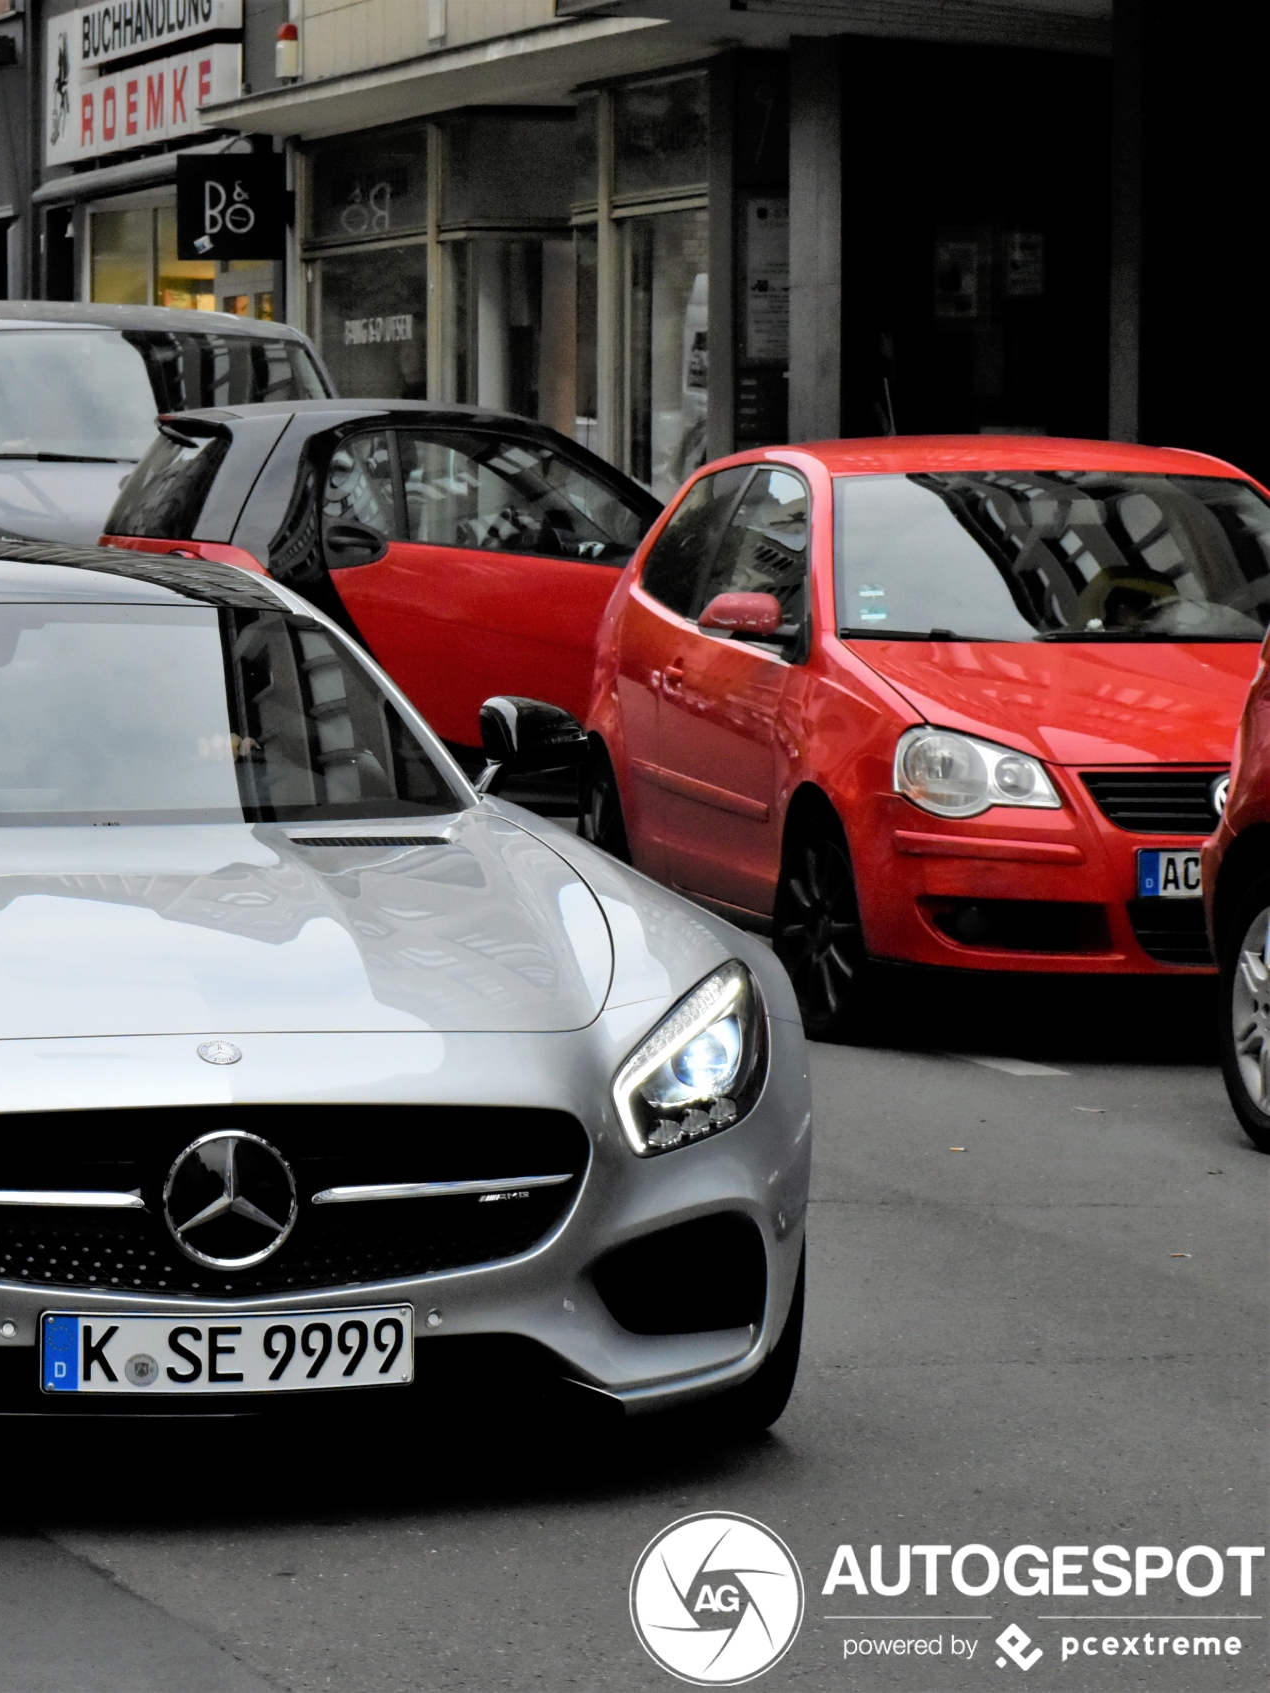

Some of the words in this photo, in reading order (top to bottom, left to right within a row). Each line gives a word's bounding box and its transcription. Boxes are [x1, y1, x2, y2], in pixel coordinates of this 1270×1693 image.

[82, 0, 212, 59] BUCHHANDLUNG
[81, 59, 212, 147] ROEMKE
[1145, 878, 1154, 889] D
[1163, 857, 1200, 890] AC
[54, 1362, 67, 1378] D
[82, 1325, 119, 1382] K
[166, 1326, 243, 1383] SE
[263, 1318, 404, 1381] 9999
